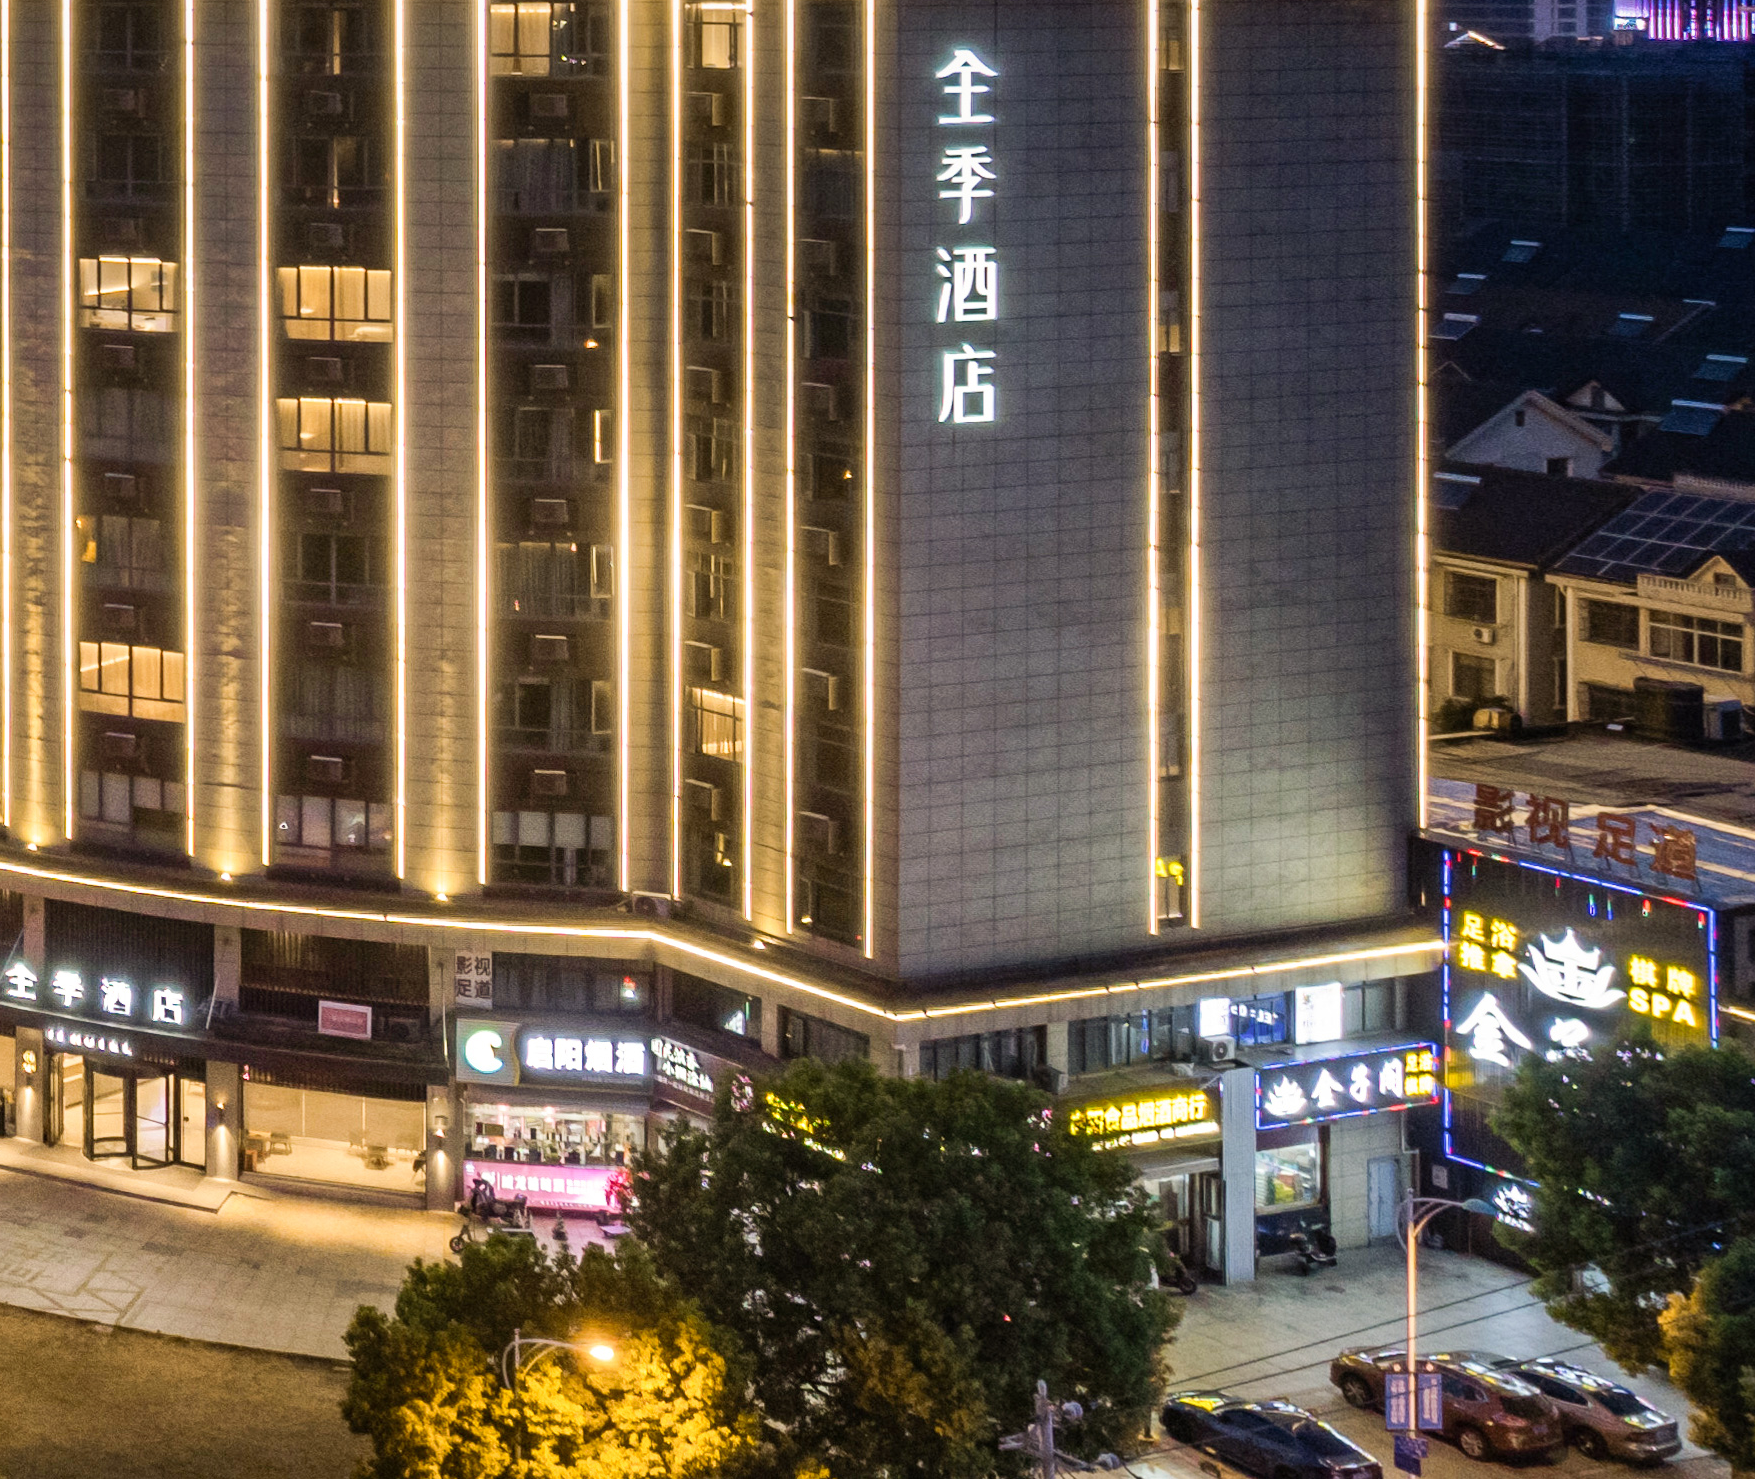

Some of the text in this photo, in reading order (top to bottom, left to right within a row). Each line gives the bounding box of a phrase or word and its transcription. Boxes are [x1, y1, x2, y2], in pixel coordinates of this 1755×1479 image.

[935, 49, 1000, 424] 全季酒店
[1473, 783, 1698, 881] 影视足道
[1460, 911, 1518, 952] 足浴
[456, 955, 491, 976] 影视
[1459, 941, 1518, 979] 推拿
[1628, 954, 1698, 999] 棋牌
[5, 962, 185, 1025] 全季酒店
[456, 979, 491, 999] 足道
[1628, 987, 1698, 1028] SPA
